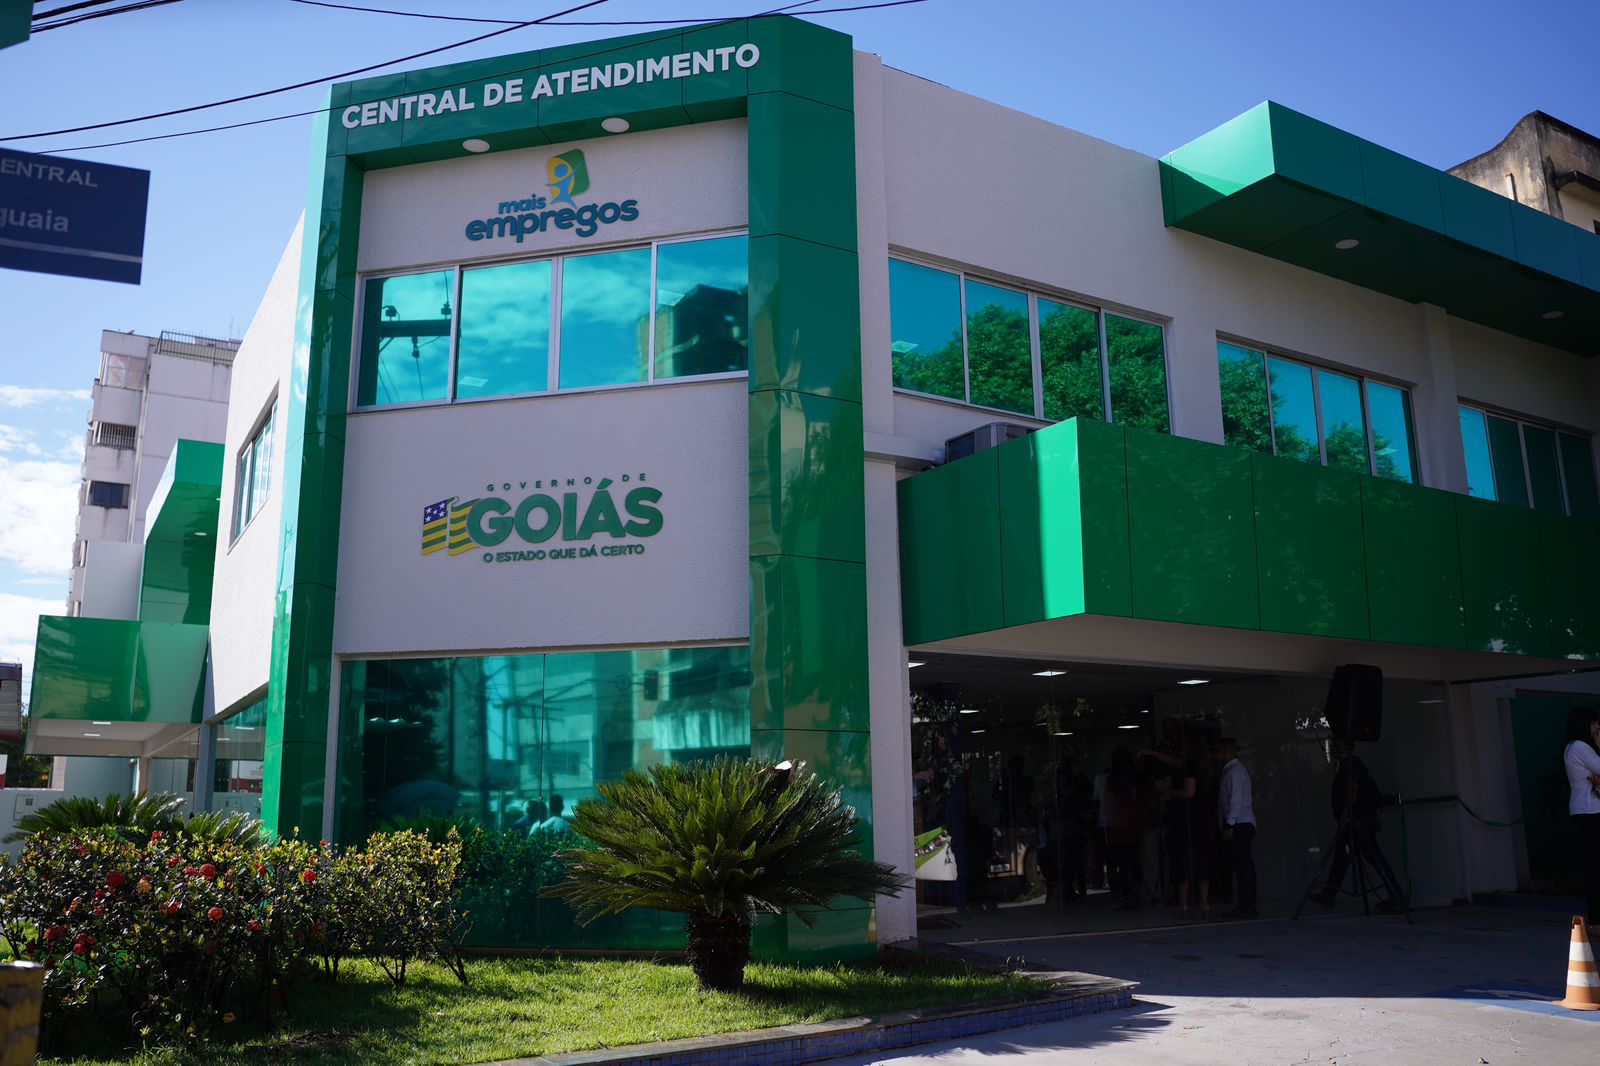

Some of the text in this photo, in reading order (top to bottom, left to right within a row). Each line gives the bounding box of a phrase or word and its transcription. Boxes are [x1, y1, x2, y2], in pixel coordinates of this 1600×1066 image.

[342, 43, 760, 128] CENTRAL DE ATENDIMENTO
[498, 193, 546, 214] mais
[465, 199, 639, 243] empregos
[486, 473, 646, 492] GOVERNO DE
[466, 478, 664, 547] GOIÁS
[483, 544, 645, 563] O ESTADO QUE DÁ CERTO
